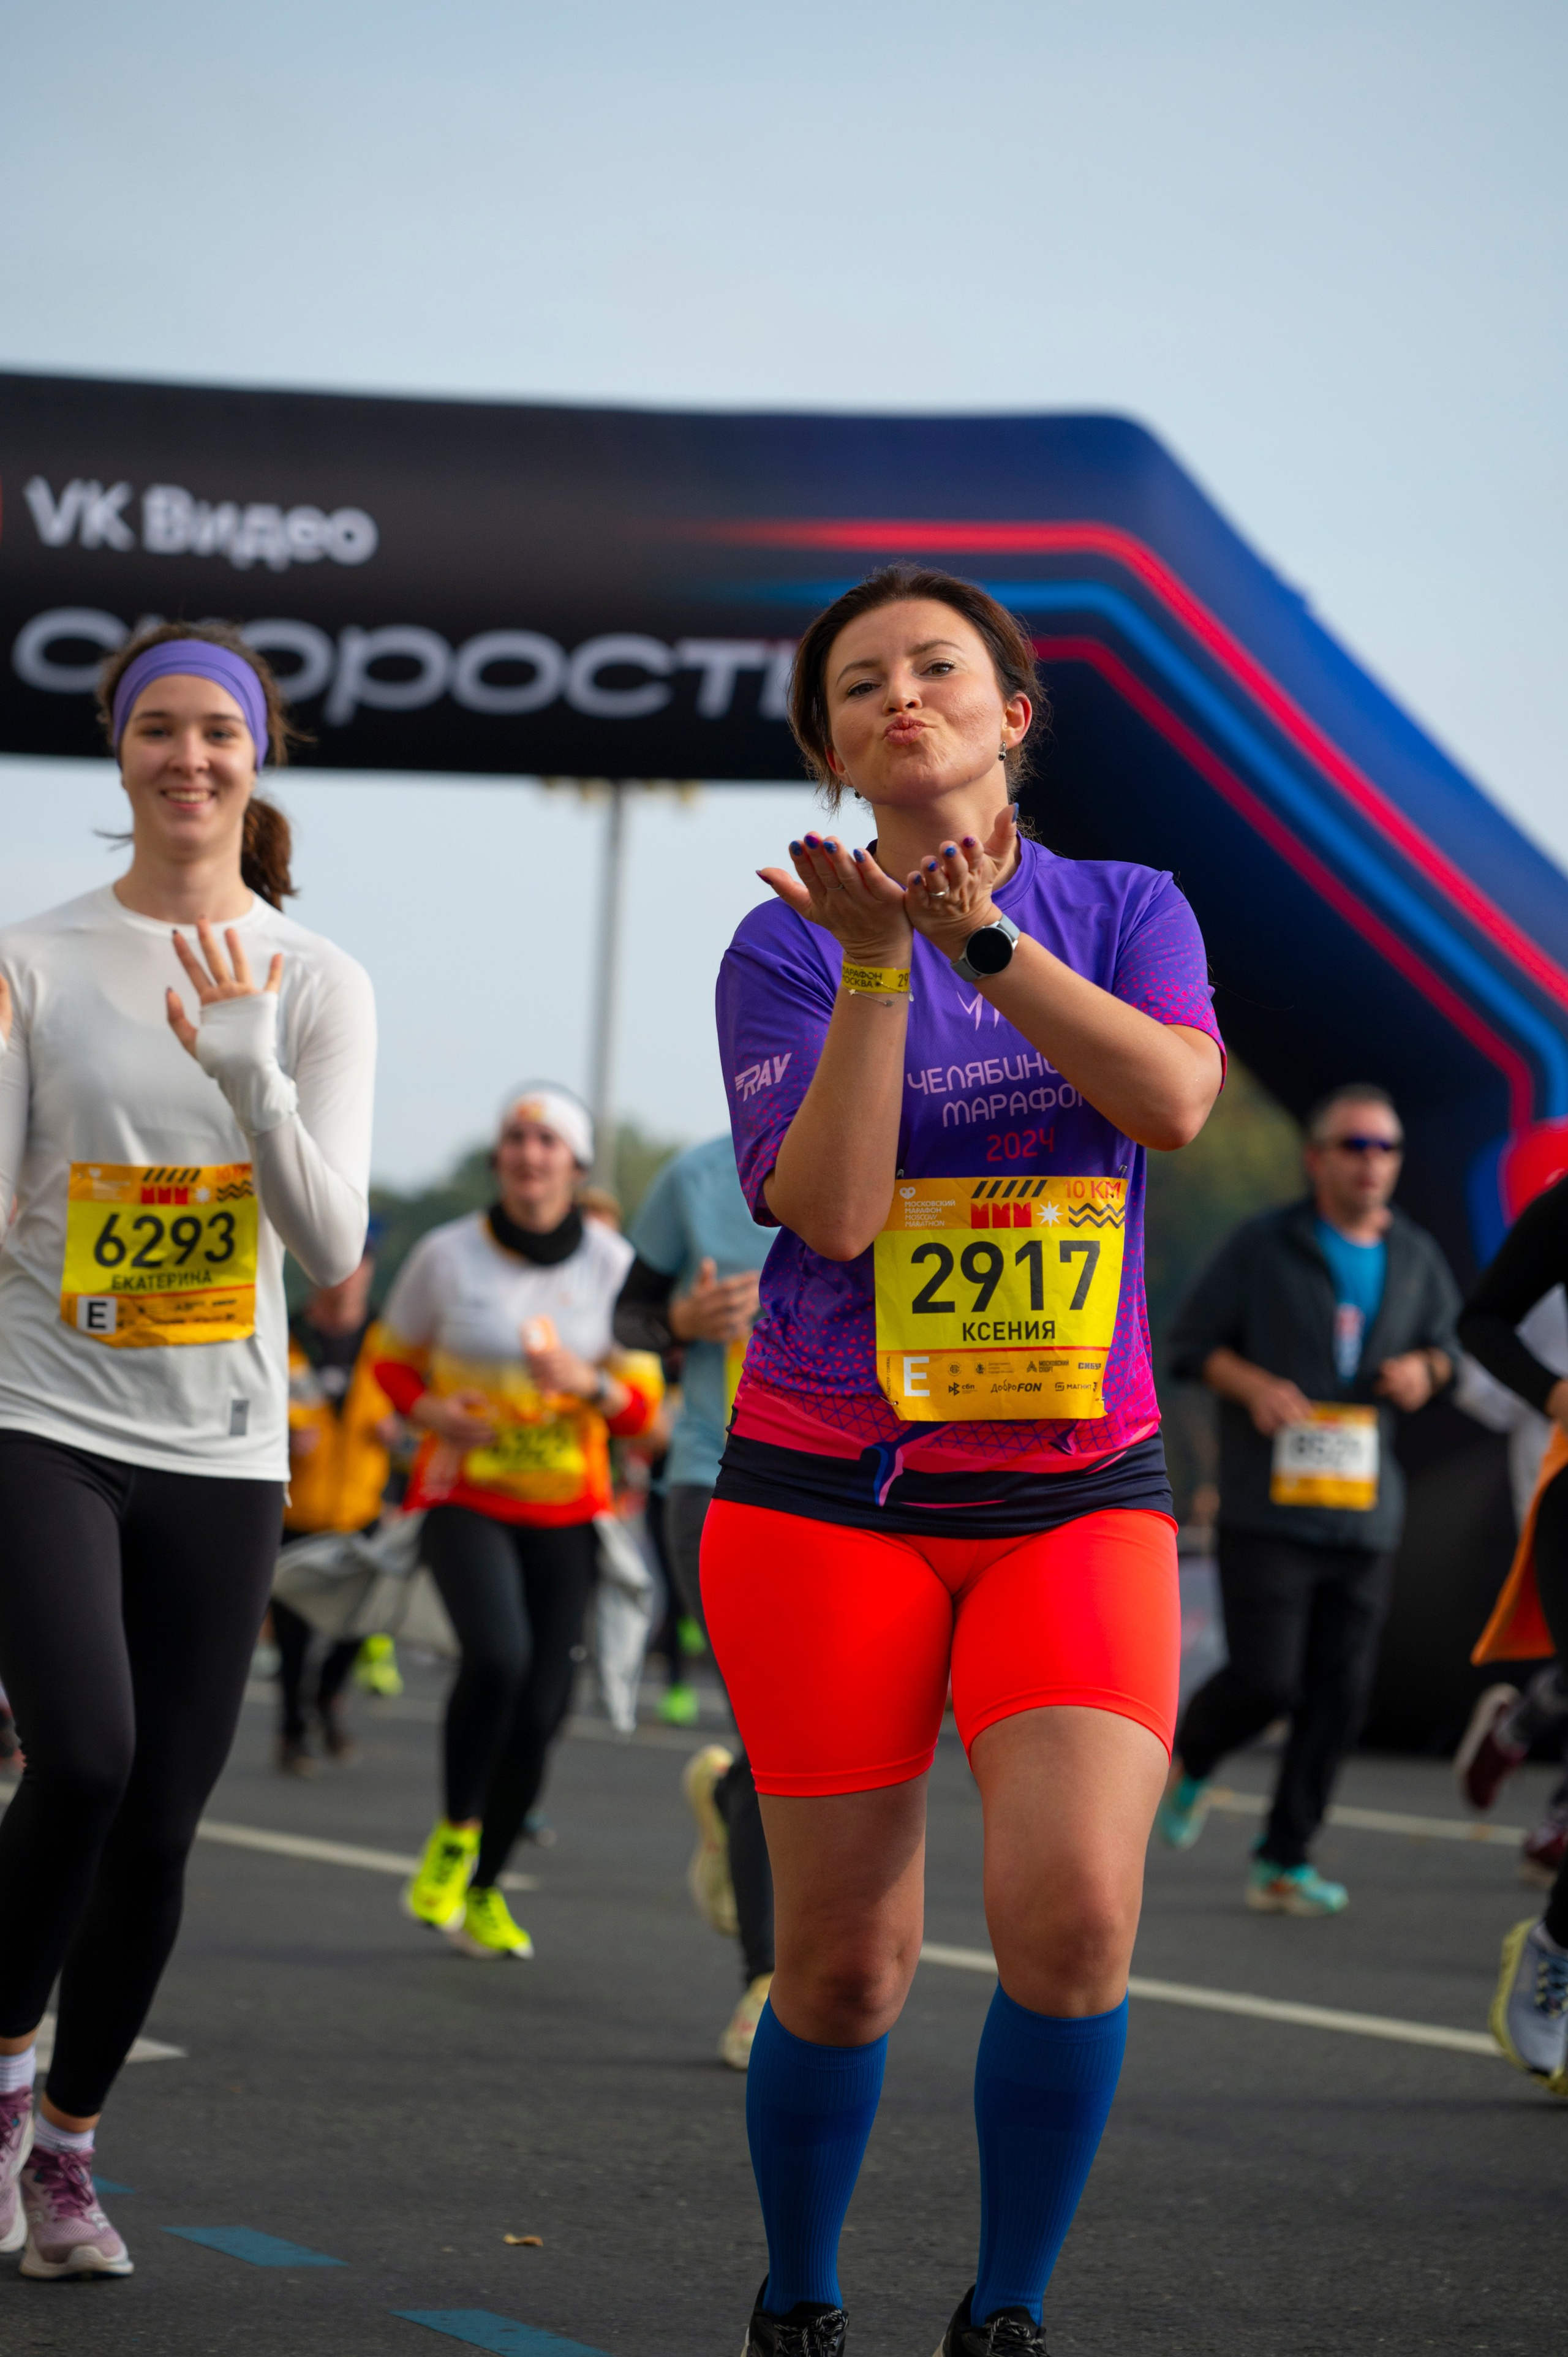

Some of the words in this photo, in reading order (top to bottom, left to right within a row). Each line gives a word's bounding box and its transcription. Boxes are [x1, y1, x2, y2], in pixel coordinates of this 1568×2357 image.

[23, 475, 134, 549] VK
[141, 483, 378, 571] Видео
[986, 1126, 1055, 1163] 2024
[1066, 1180, 1085, 1199] 10
[94, 1212, 235, 1268] 6293
[111, 1270, 212, 1291] ЕКАТЕРИНА
[911, 1240, 1100, 1314] 2917
[962, 1321, 1055, 1341] КСЕНИЯ
